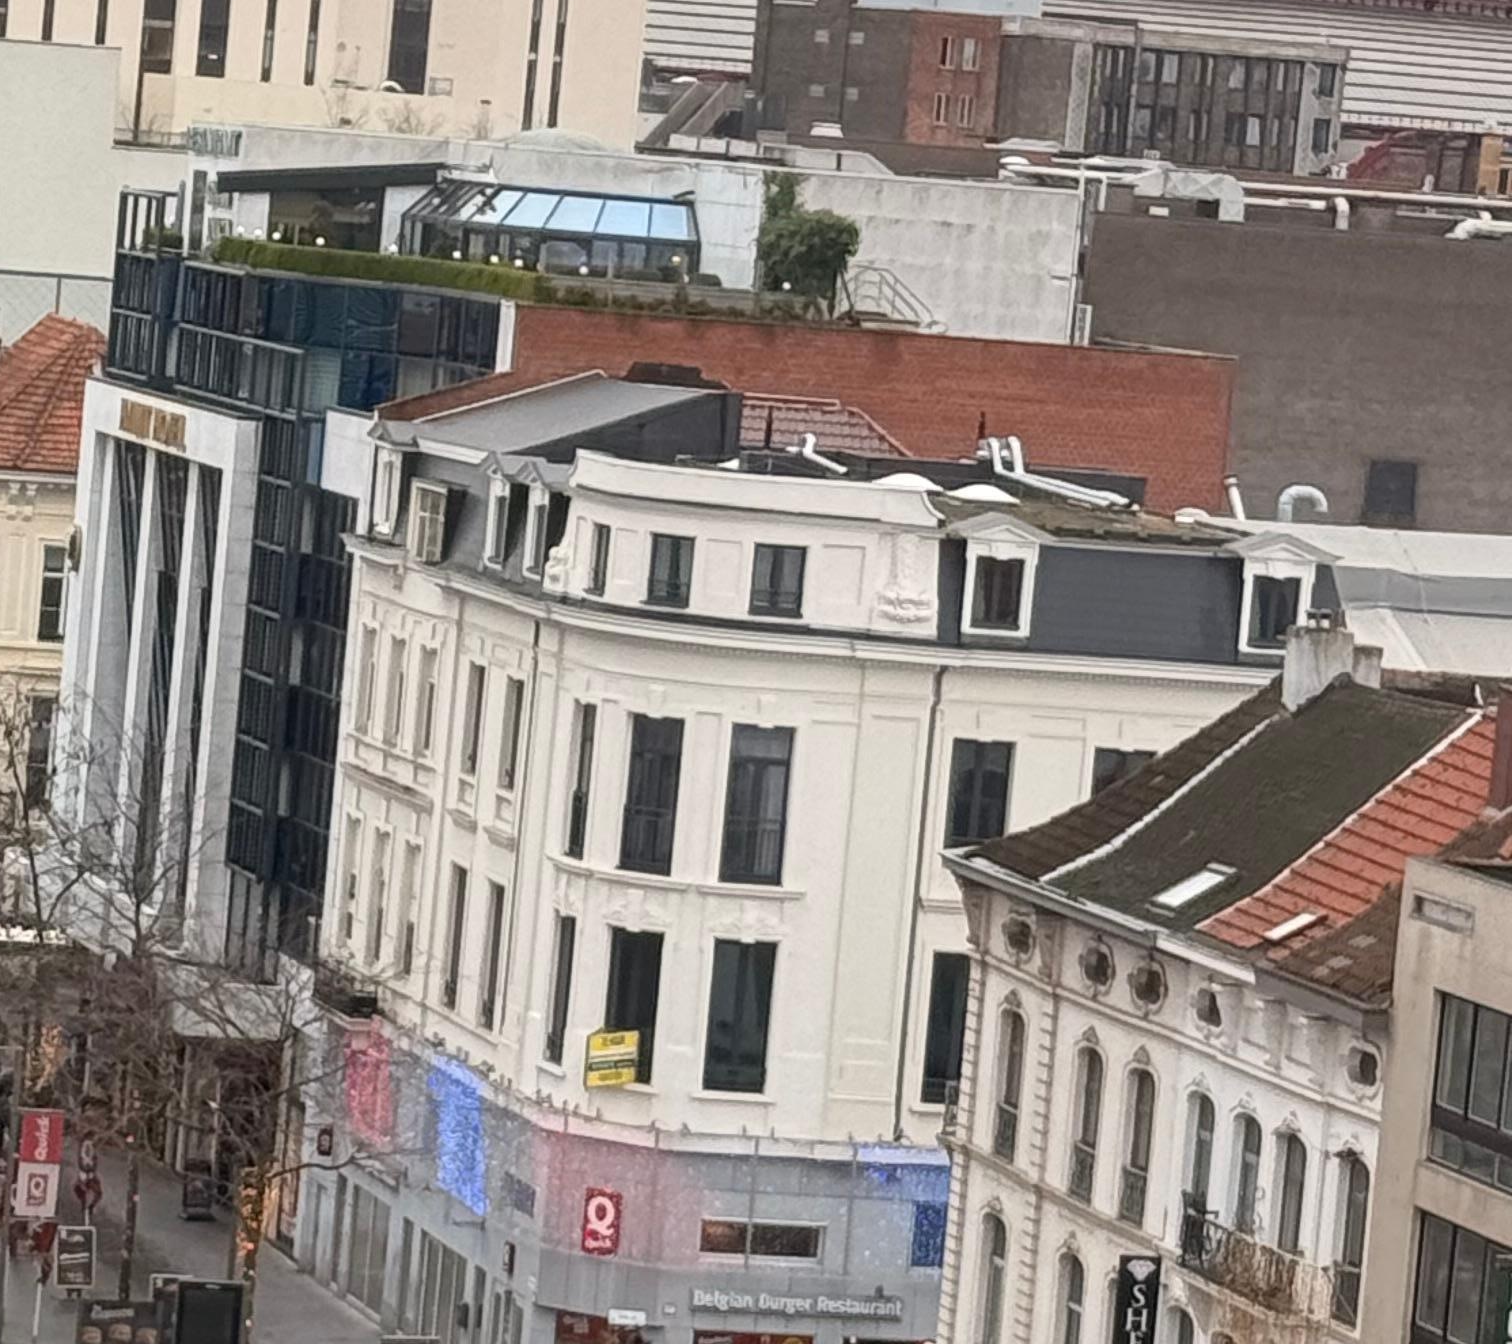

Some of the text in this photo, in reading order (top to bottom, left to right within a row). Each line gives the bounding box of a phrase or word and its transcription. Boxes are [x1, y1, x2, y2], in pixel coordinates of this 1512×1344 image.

[587, 1195, 615, 1236] Q
[693, 1289, 903, 1317] Belgian Burger Restaurant
